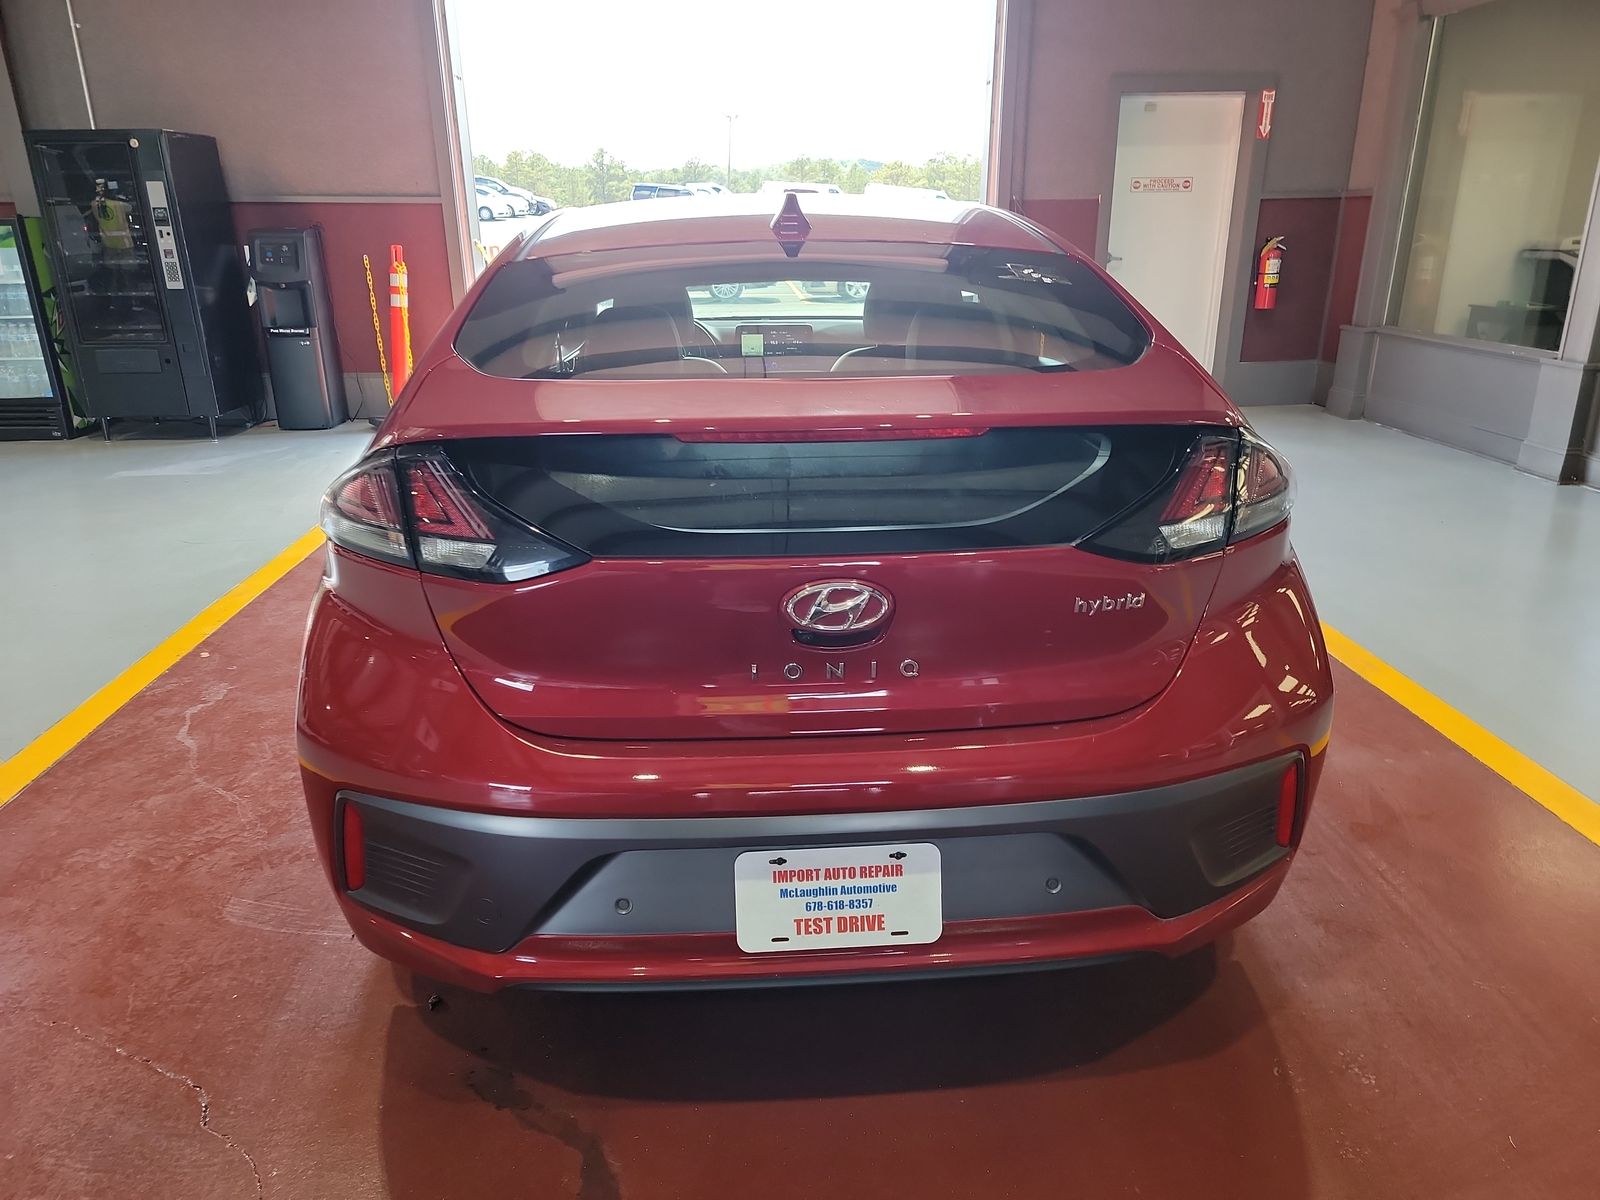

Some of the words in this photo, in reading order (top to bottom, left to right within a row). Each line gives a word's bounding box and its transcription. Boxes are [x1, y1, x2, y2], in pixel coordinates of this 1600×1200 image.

[1074, 592, 1146, 616] hybrid
[751, 658, 920, 680] IONIQ
[772, 867, 821, 884] IMPORT
[824, 866, 857, 881] AUTO
[859, 864, 903, 878] REPAIR
[779, 885, 838, 899] McLaughlin
[840, 882, 897, 896] Automotive
[805, 898, 873, 912] 678-618-8357
[793, 916, 836, 936] TEST
[837, 914, 886, 934] DRIVE
